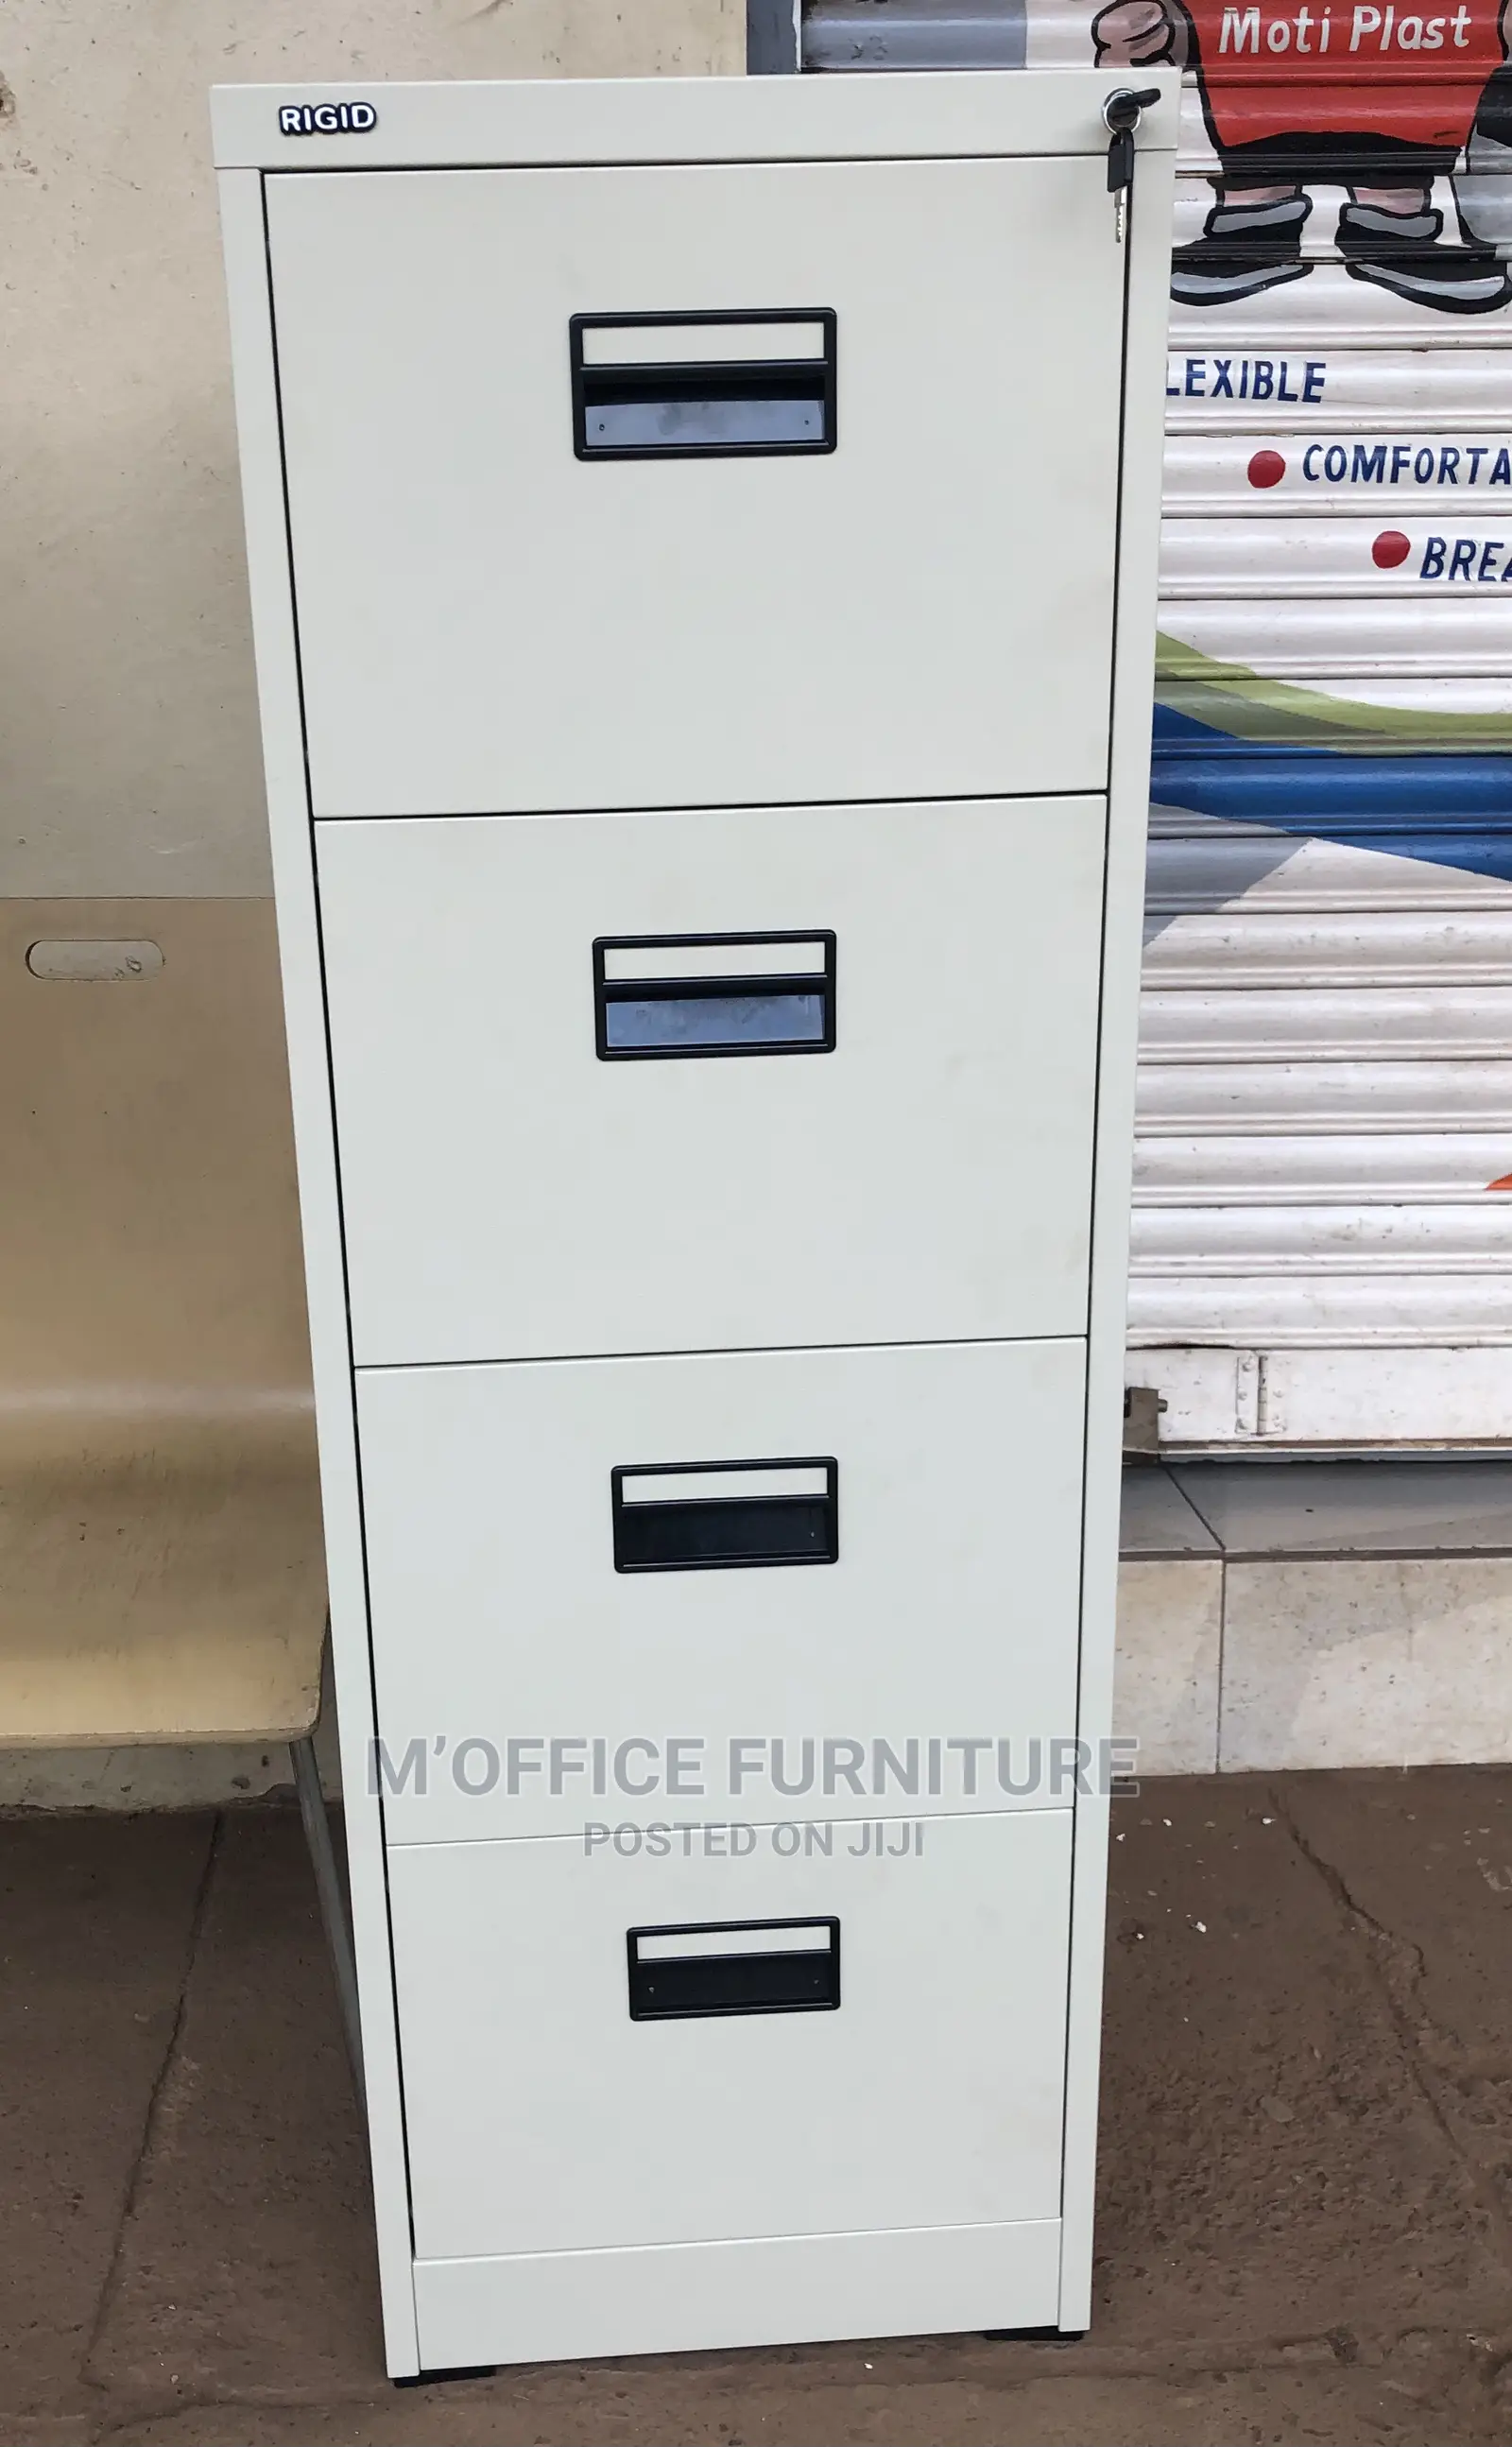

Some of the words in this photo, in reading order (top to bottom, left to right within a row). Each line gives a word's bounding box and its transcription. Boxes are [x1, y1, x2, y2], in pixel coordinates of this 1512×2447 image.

[1218, 6, 1330, 54] Moti
[1349, 6, 1472, 52] Plast
[280, 103, 376, 135] RIGID
[1302, 443, 1511, 485] COMFORTA
